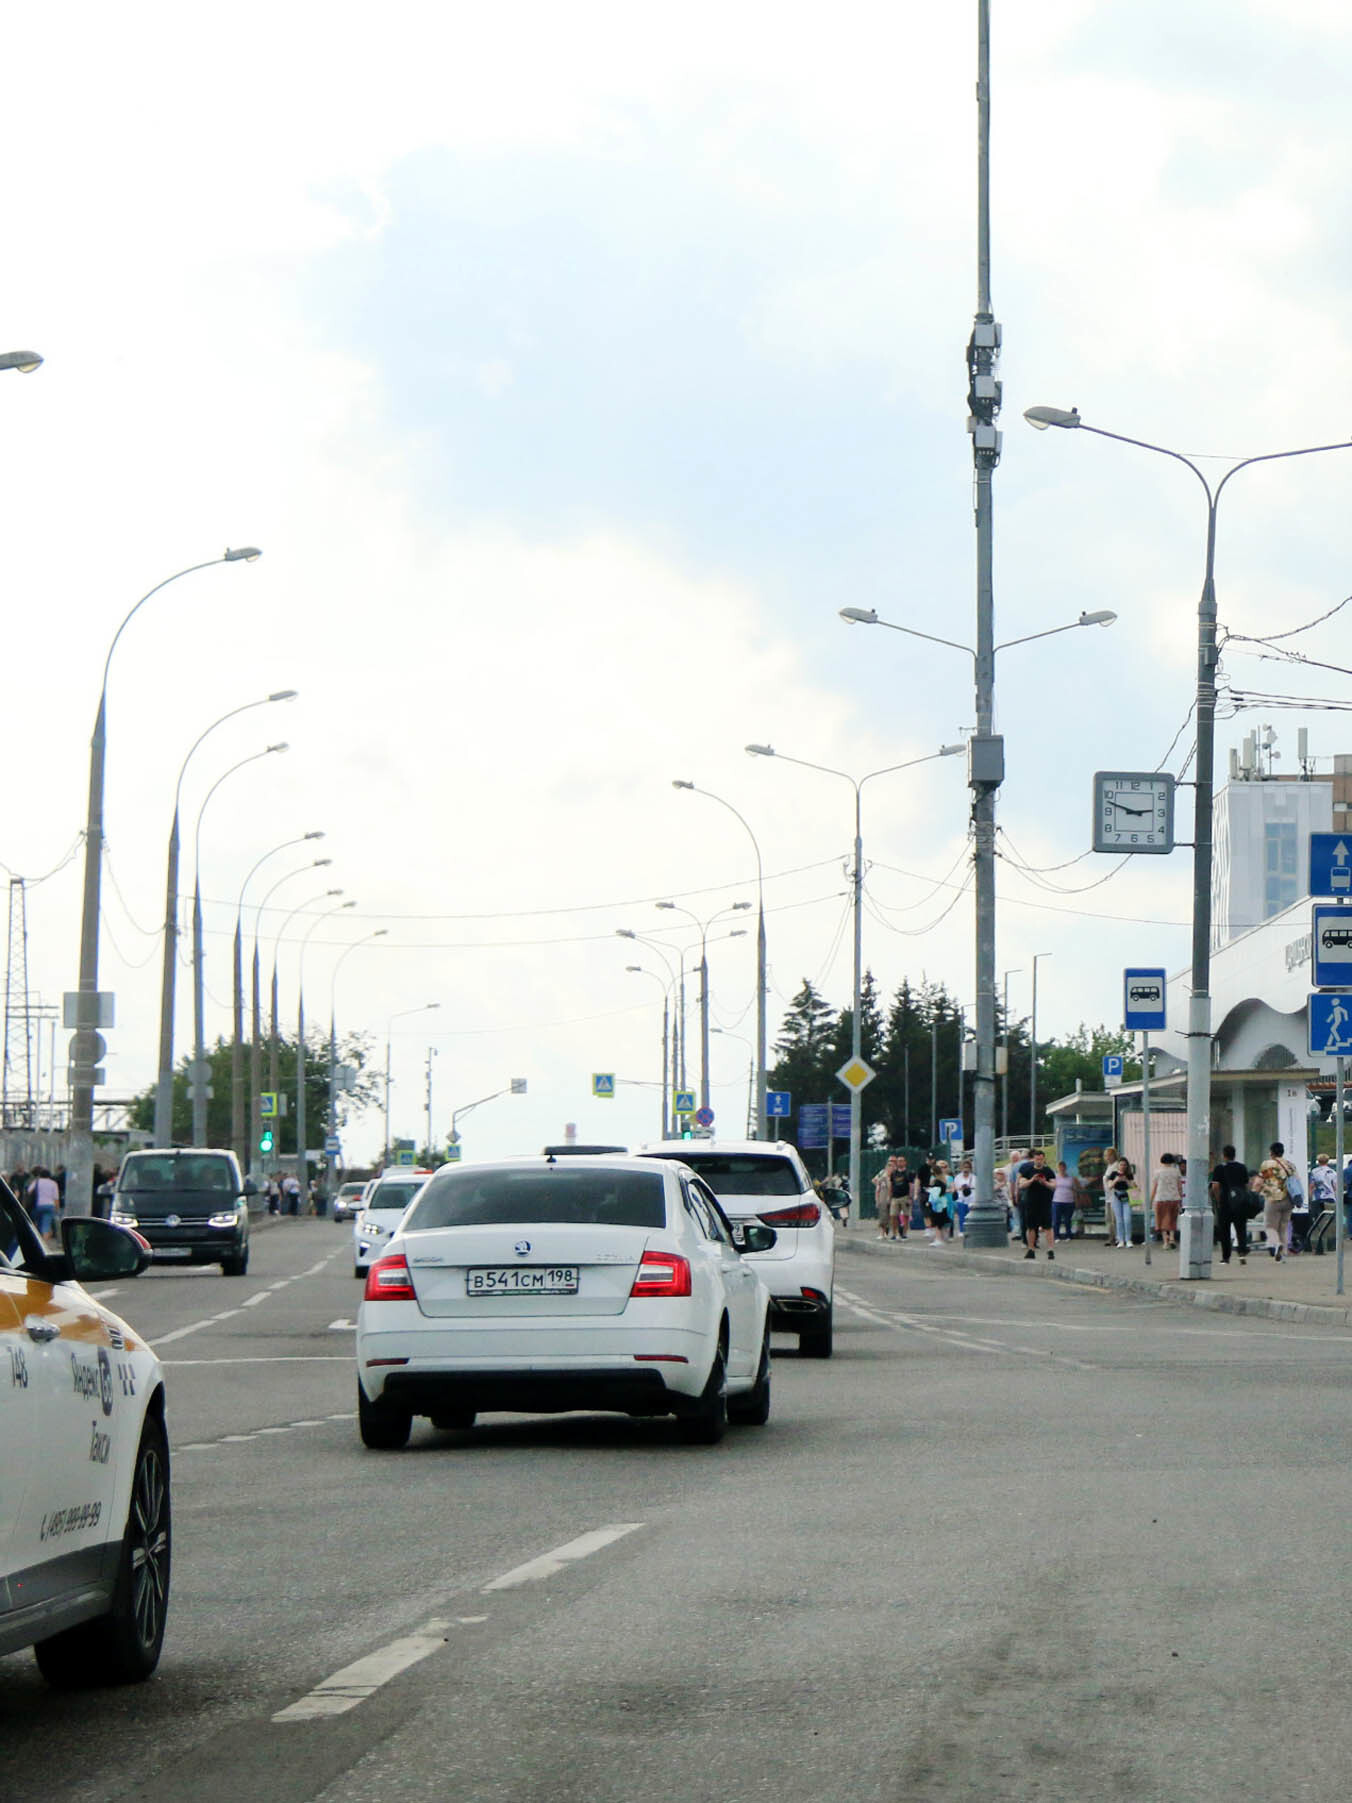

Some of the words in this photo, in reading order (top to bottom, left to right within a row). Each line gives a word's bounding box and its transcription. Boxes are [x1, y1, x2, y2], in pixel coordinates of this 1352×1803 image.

[1157, 792, 1166, 801] 2
[1157, 809, 1165, 818] 3
[1104, 824, 1112, 833] 8
[1158, 826, 1165, 834] 4
[1114, 834, 1121, 842] 7
[1131, 834, 1138, 843] 6
[1147, 834, 1154, 843] 5
[1108, 1057, 1120, 1073] P
[945, 1121, 958, 1138] P
[474, 1271, 544, 1288] В541СМ
[547, 1270, 573, 1282] 198
[89, 1420, 111, 1464] Такси
